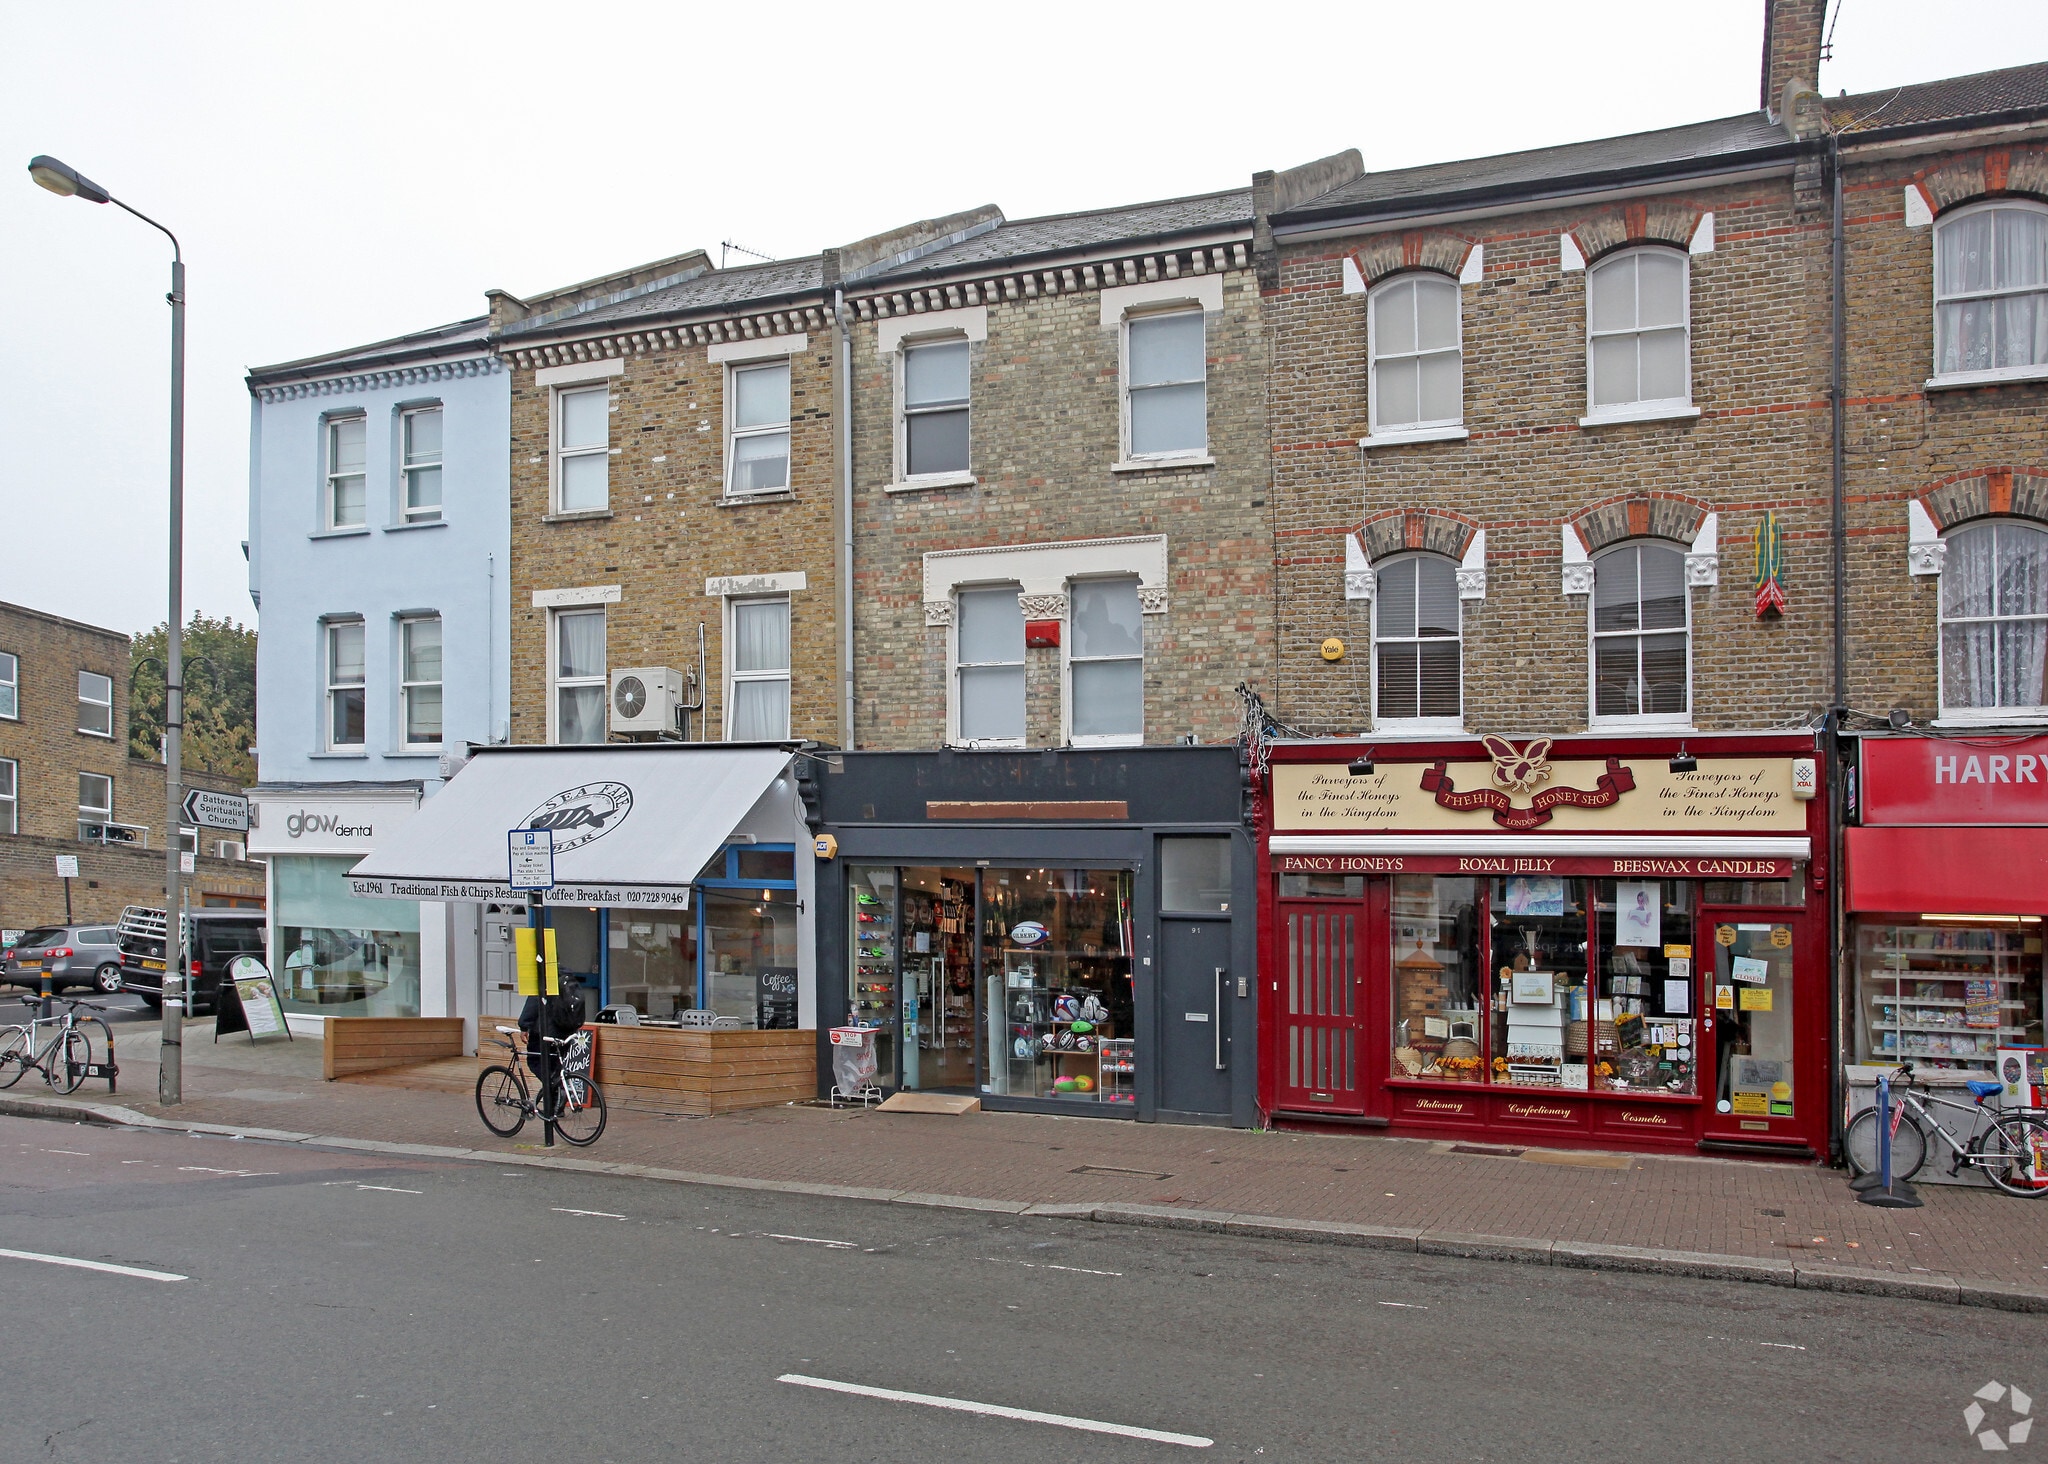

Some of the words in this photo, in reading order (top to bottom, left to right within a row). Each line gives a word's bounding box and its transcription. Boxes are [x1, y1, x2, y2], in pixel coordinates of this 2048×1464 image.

[1323, 645, 1339, 653] Yale
[1311, 773, 1368, 788] Purveyors
[1374, 774, 1387, 788] of
[1676, 771, 1741, 785] Purveyors
[1749, 769, 1765, 785] of
[202, 794, 242, 808] Battersea
[545, 787, 588, 810] SEA
[1297, 790, 1314, 801] the
[1318, 790, 1356, 801] Finest
[1356, 790, 1400, 804] Honeys
[1444, 793, 1472, 806] THE
[1473, 793, 1507, 809] HIVE
[1537, 792, 1580, 808] HONEY
[1581, 792, 1610, 805] SHOP
[1659, 788, 1679, 799] the
[1683, 787, 1725, 799] Finest
[1728, 787, 1780, 802] Honeys
[200, 803, 246, 818] Spiritualist
[1301, 808, 1313, 817] in
[1319, 807, 1336, 817] the
[1341, 806, 1398, 821] Kingdom
[1662, 807, 1678, 816] in
[1684, 805, 1704, 816] the
[1710, 805, 1777, 821] Kingdom
[207, 814, 238, 825] Church
[287, 809, 339, 838] glow
[335, 824, 373, 837] dental
[1506, 817, 1538, 826] LONDON
[526, 834, 534, 844] P
[1284, 857, 1335, 870] FANCY
[1339, 857, 1404, 870] HONEYS
[1459, 858, 1509, 871] ROYAL
[1512, 858, 1556, 873] JELLY
[1613, 860, 1690, 873] BEESWAX
[1697, 860, 1776, 874] CANDLES
[391, 883, 438, 897] Traditional
[441, 885, 459, 897] Fish
[460, 887, 468, 897] &
[468, 886, 494, 901] Chips
[495, 886, 527, 900] Restaur
[626, 892, 641, 903] 020
[641, 893, 660, 903] 7228
[661, 892, 683, 904] 9046
[762, 973, 791, 991] Coffee
[1416, 1099, 1463, 1112] Stationary
[1508, 1103, 1571, 1118] Confectionary
[1621, 1111, 1667, 1124] Cosmetics
